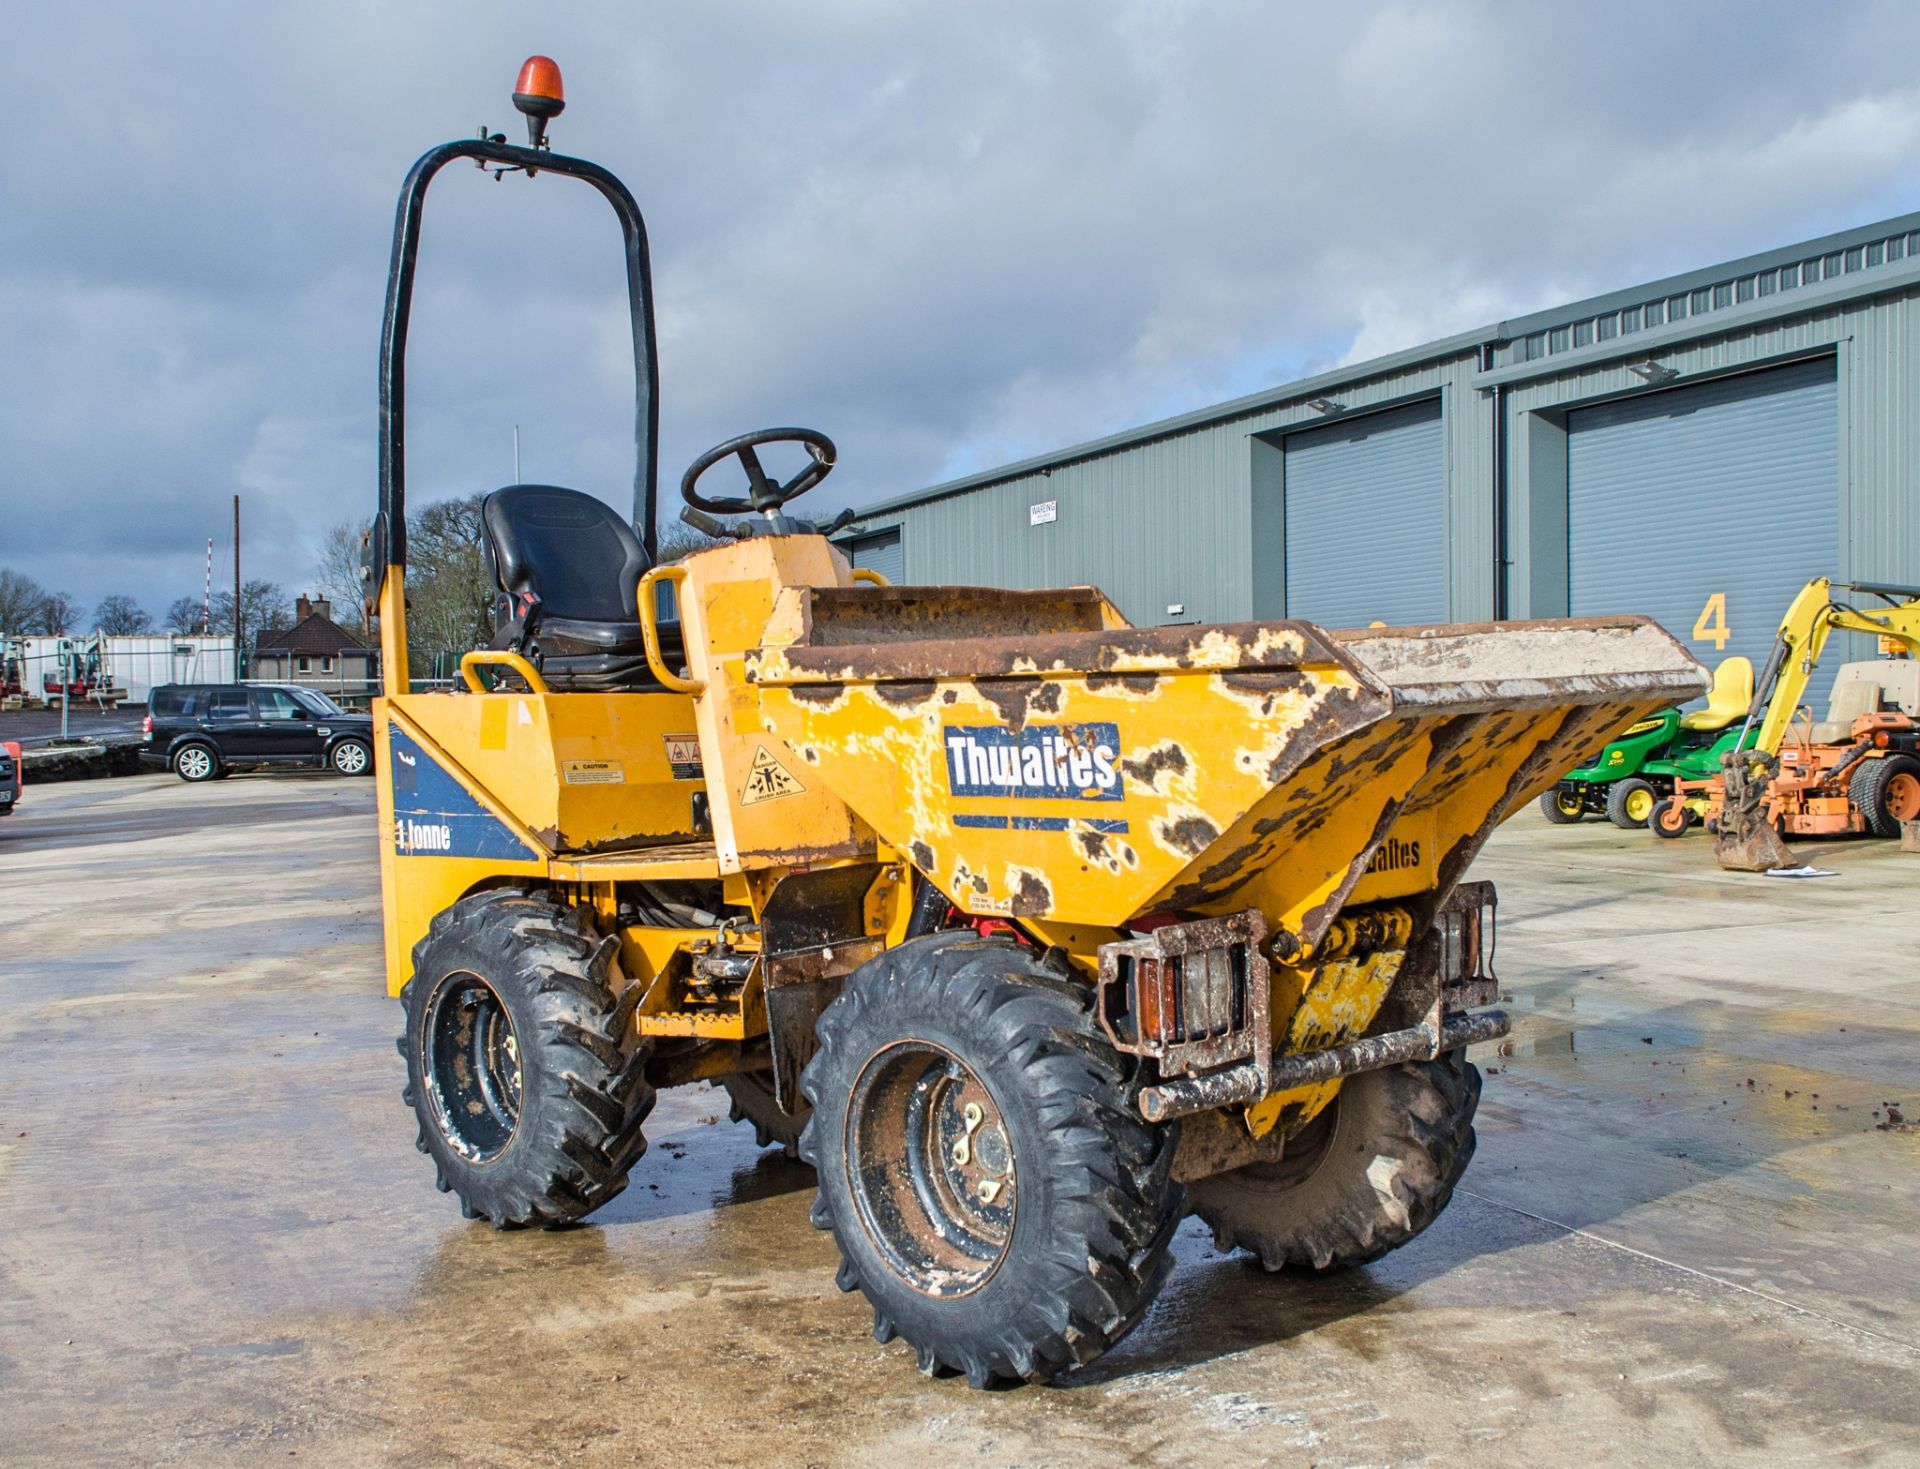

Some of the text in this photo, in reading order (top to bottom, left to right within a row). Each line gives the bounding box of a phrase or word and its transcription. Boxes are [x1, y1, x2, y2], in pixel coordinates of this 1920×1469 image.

[1693, 593, 1730, 650] 4
[754, 761, 777, 769] DANGER
[948, 736, 1117, 788] Thwaites
[754, 793, 775, 801] CRUSH
